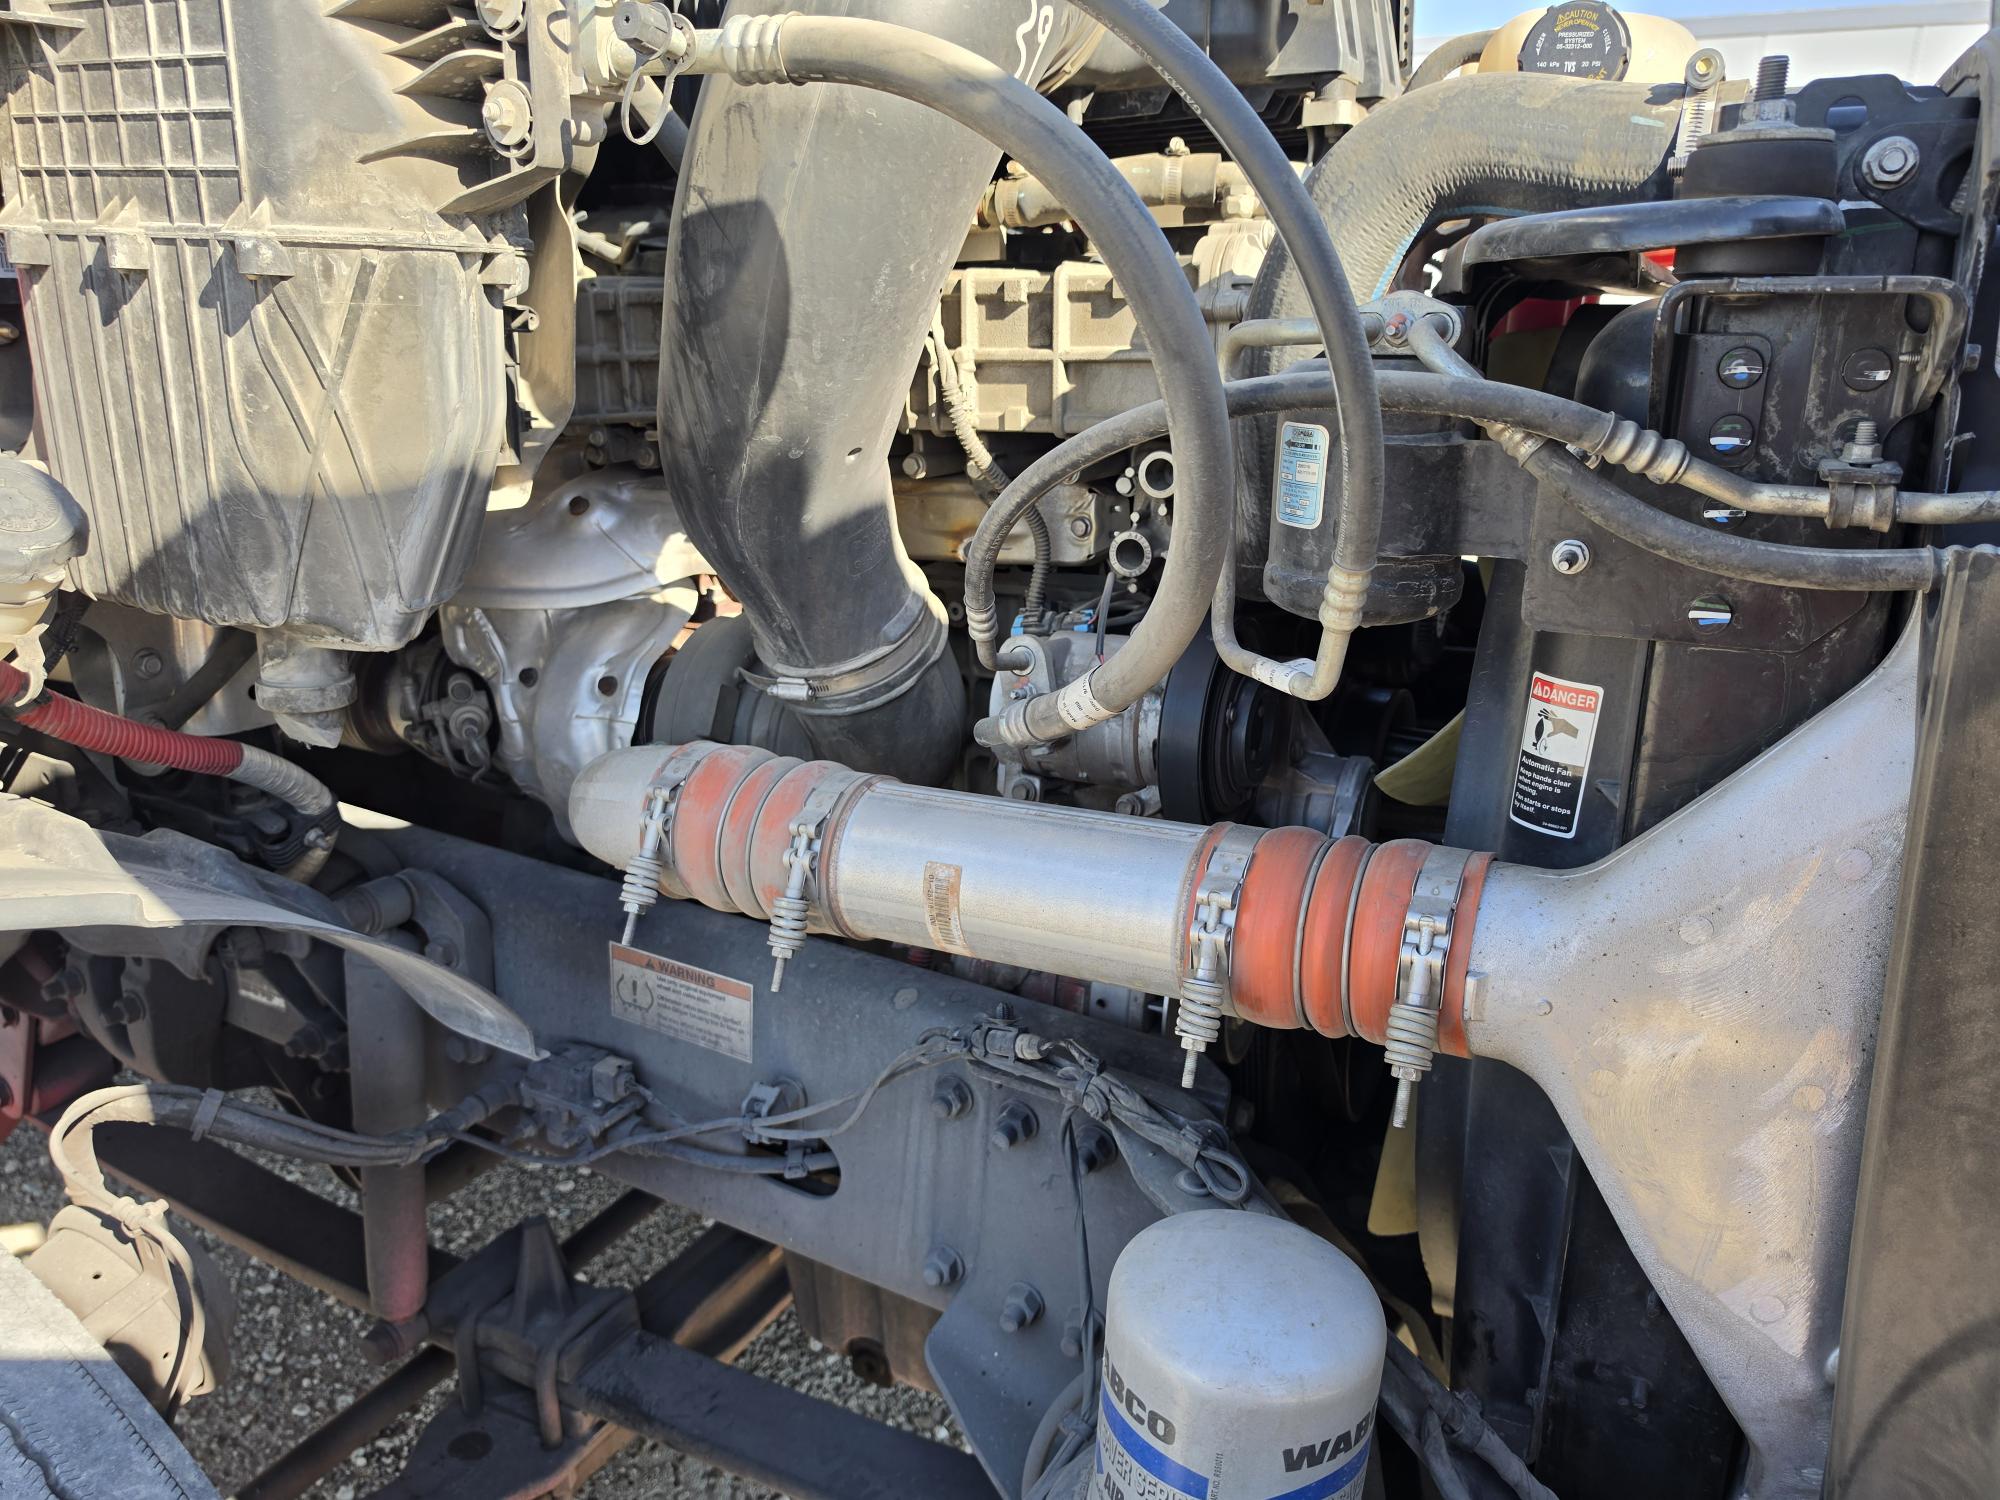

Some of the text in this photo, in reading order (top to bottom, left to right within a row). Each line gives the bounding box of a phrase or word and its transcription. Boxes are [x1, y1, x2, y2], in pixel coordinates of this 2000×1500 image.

[1565, 9, 1599, 21] CAUTION
[1543, 686, 1595, 709] DANGER
[1521, 755, 1572, 777] Automatic Fan
[1518, 775, 1561, 794] when engine is
[1519, 767, 1572, 788] Keep hands clear
[1517, 782, 1537, 796] running.
[1515, 792, 1524, 802] Fan
[1523, 796, 1541, 808] starts
[1550, 804, 1571, 815] stops
[1520, 801, 1535, 813] itself.
[658, 961, 716, 987] WARNING
[1104, 1346, 1176, 1445] ABCO
[1283, 1405, 1374, 1472] WAB
